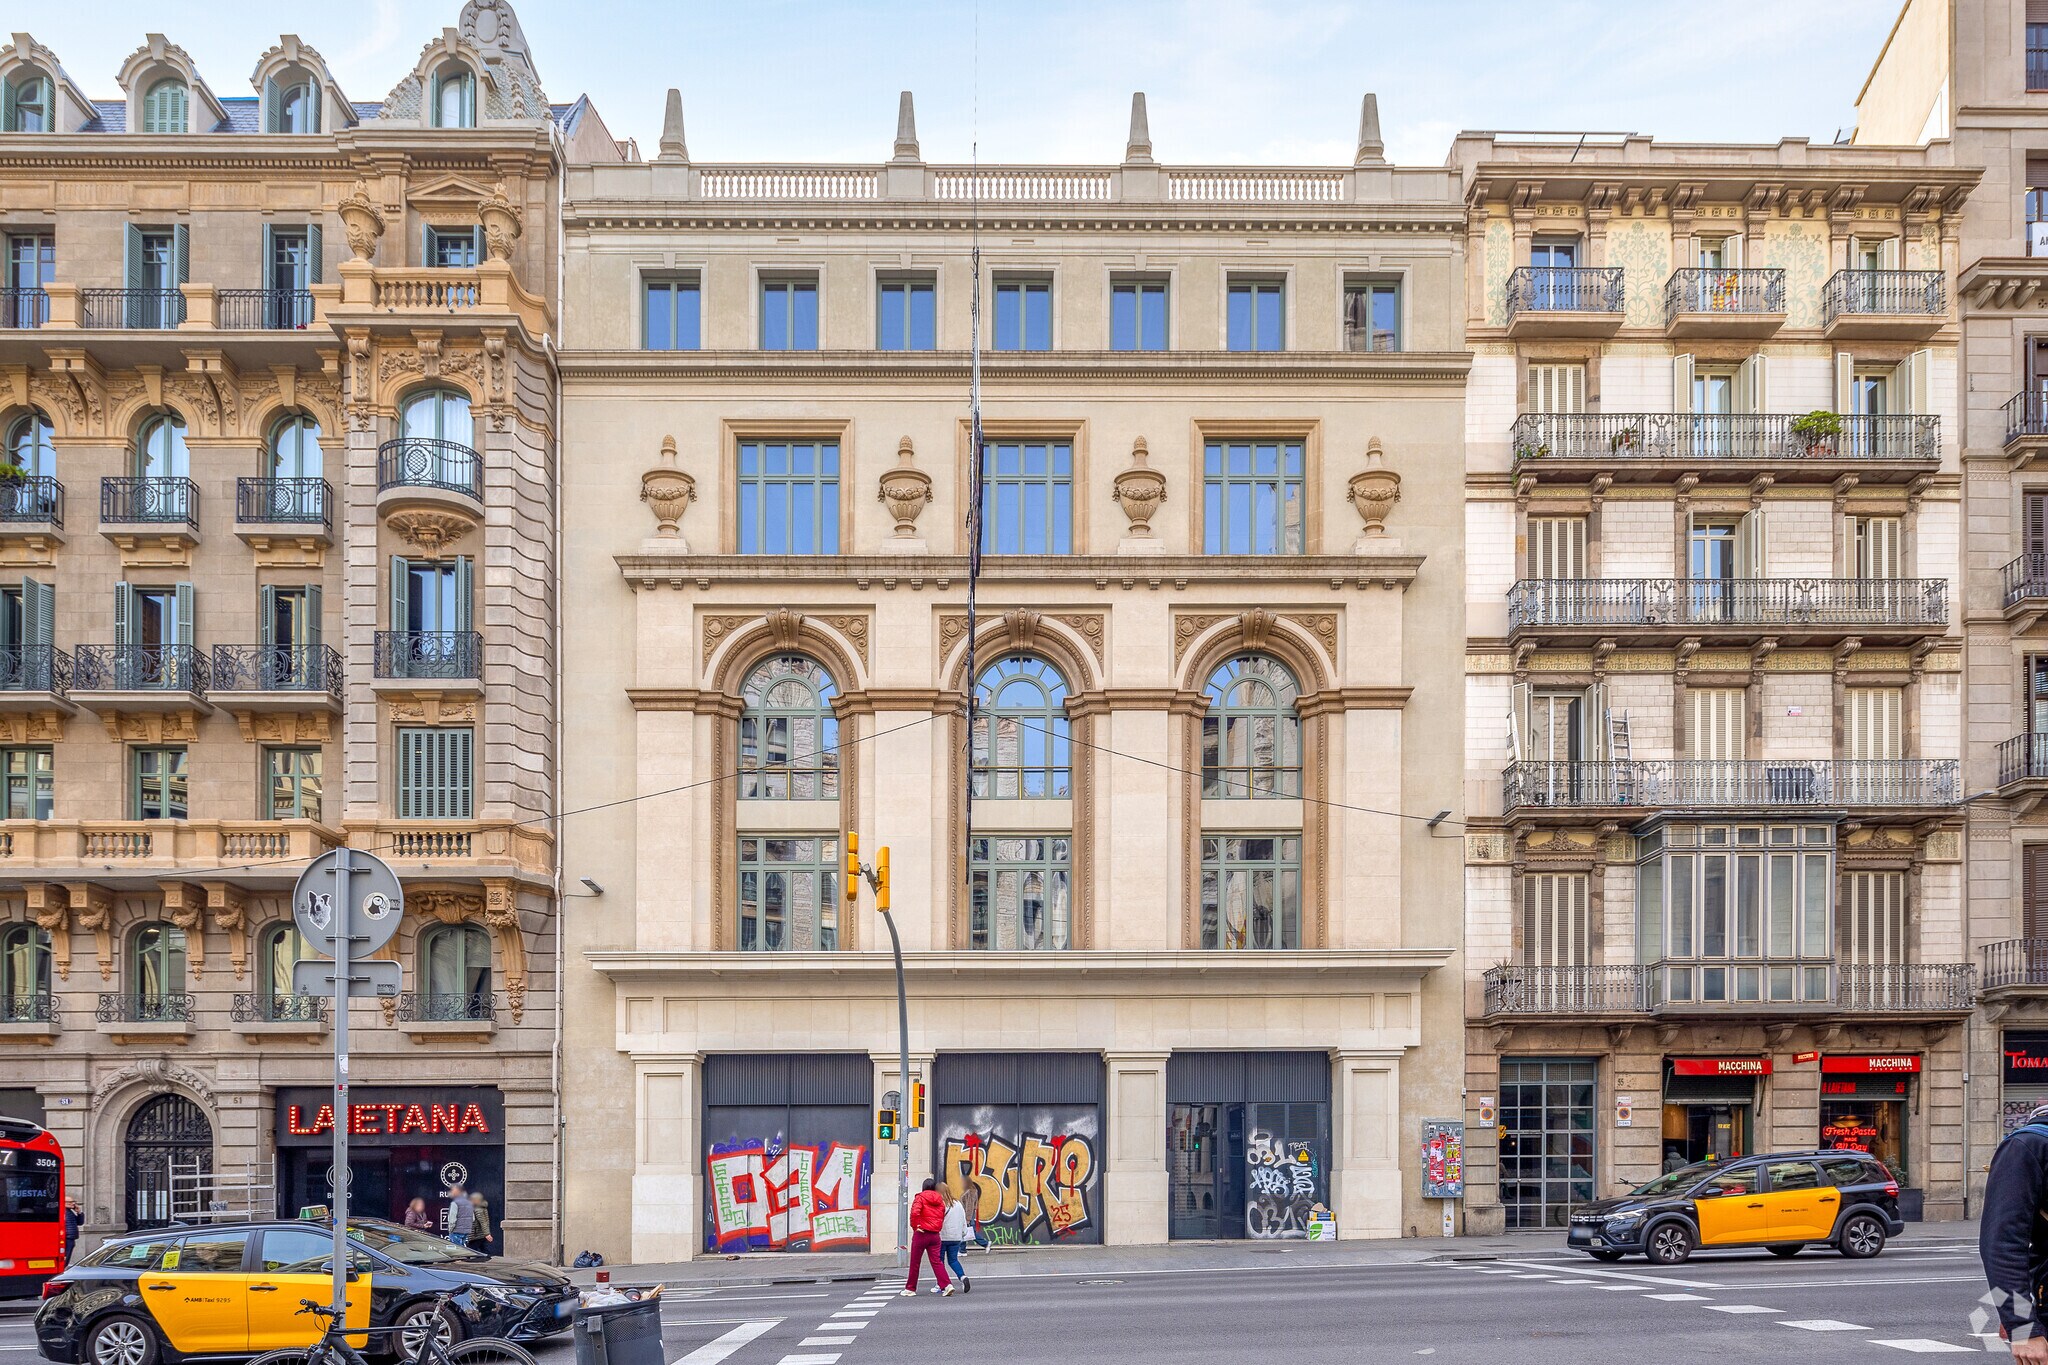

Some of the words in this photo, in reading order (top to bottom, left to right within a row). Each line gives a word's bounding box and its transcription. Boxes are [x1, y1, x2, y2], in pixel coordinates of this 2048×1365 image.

[1718, 1061, 1762, 1070] MACCHINA
[1869, 1058, 1913, 1067] MACCHINA
[289, 1103, 490, 1135] LAETANA
[1825, 1127, 1850, 1136] Fresh
[1851, 1127, 1876, 1136] Pasta
[36, 1159, 56, 1167] 3504
